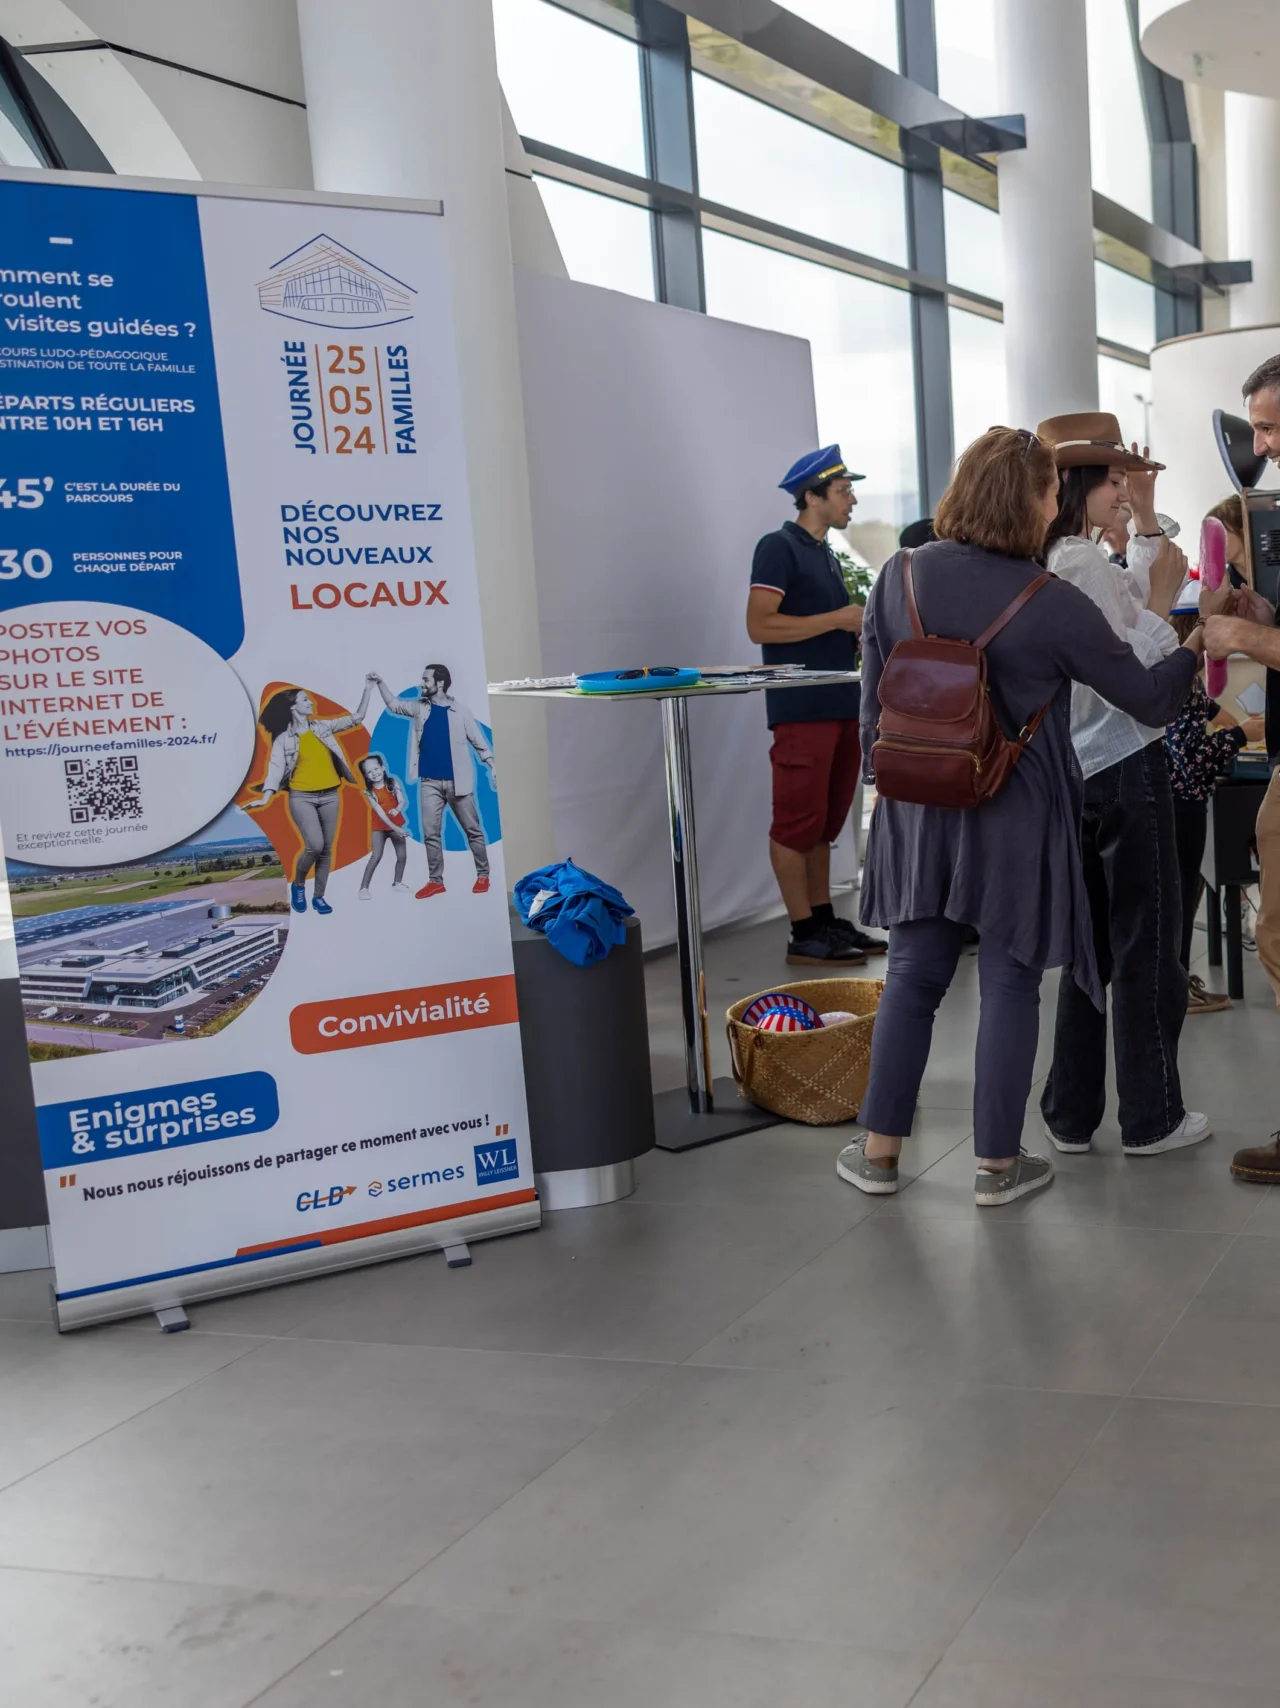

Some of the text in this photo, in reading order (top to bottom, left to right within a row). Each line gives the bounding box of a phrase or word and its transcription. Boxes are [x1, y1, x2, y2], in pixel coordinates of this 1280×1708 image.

[88, 273, 114, 287] se
[0, 290, 82, 310] oulent
[5, 314, 196, 338] visites guidées ?
[40, 348, 168, 362] LUDO-PÉDAGOGIQUE
[326, 344, 366, 375] 25
[0, 360, 196, 374] STINATION DE TOUTE LA FAMILLE
[80, 394, 196, 413] RÉGULIERS
[280, 340, 316, 454] JOURNÉE
[329, 386, 372, 415] 05
[386, 345, 416, 454] FAMILLES
[53, 416, 92, 431] 10H
[98, 417, 123, 431] ET
[128, 418, 164, 432] 16H
[334, 426, 376, 454] 24
[64, 482, 98, 492] C'EST
[101, 482, 118, 492] LA
[120, 481, 160, 492] DURÉE
[163, 482, 181, 492] DU
[66, 494, 134, 503] PARCOURS
[280, 500, 443, 522] DÉCOUVREZ
[283, 526, 340, 544] NOS
[0, 548, 182, 580] 30 PERSONNES POUR
[285, 546, 434, 566] NOUVEAUX
[74, 561, 176, 574] CHAQUE DÉPART
[290, 580, 450, 610] LOCAUX
[96, 619, 147, 636] VOS
[0, 646, 100, 665] PHOTOS
[0, 668, 144, 691] SUR LE SITE
[1, 692, 164, 716] INTERNET DE
[4, 715, 176, 741] L'ÉVÉNEMENT
[6, 733, 218, 758] https://journeefamilles-2024.fr/
[16, 824, 148, 842] Et revivez cette journée
[17, 836, 104, 850] exceptionnelle.
[318, 992, 490, 1038] Convivialité
[69, 1092, 218, 1132] Enigmes
[72, 1107, 256, 1154] & surprises
[82, 1184, 124, 1201] Nous
[126, 1174, 164, 1194] nous
[166, 1158, 250, 1187] réjouissons
[253, 1154, 272, 1168] de
[276, 1144, 338, 1168] partager
[341, 1142, 357, 1153] ce
[360, 1126, 417, 1150] moment
[420, 1123, 450, 1138] avec
[452, 1116, 483, 1132] vous
[485, 1114, 490, 1126] !
[476, 1148, 516, 1170] WL
[296, 1164, 465, 1212] CLD sermes
